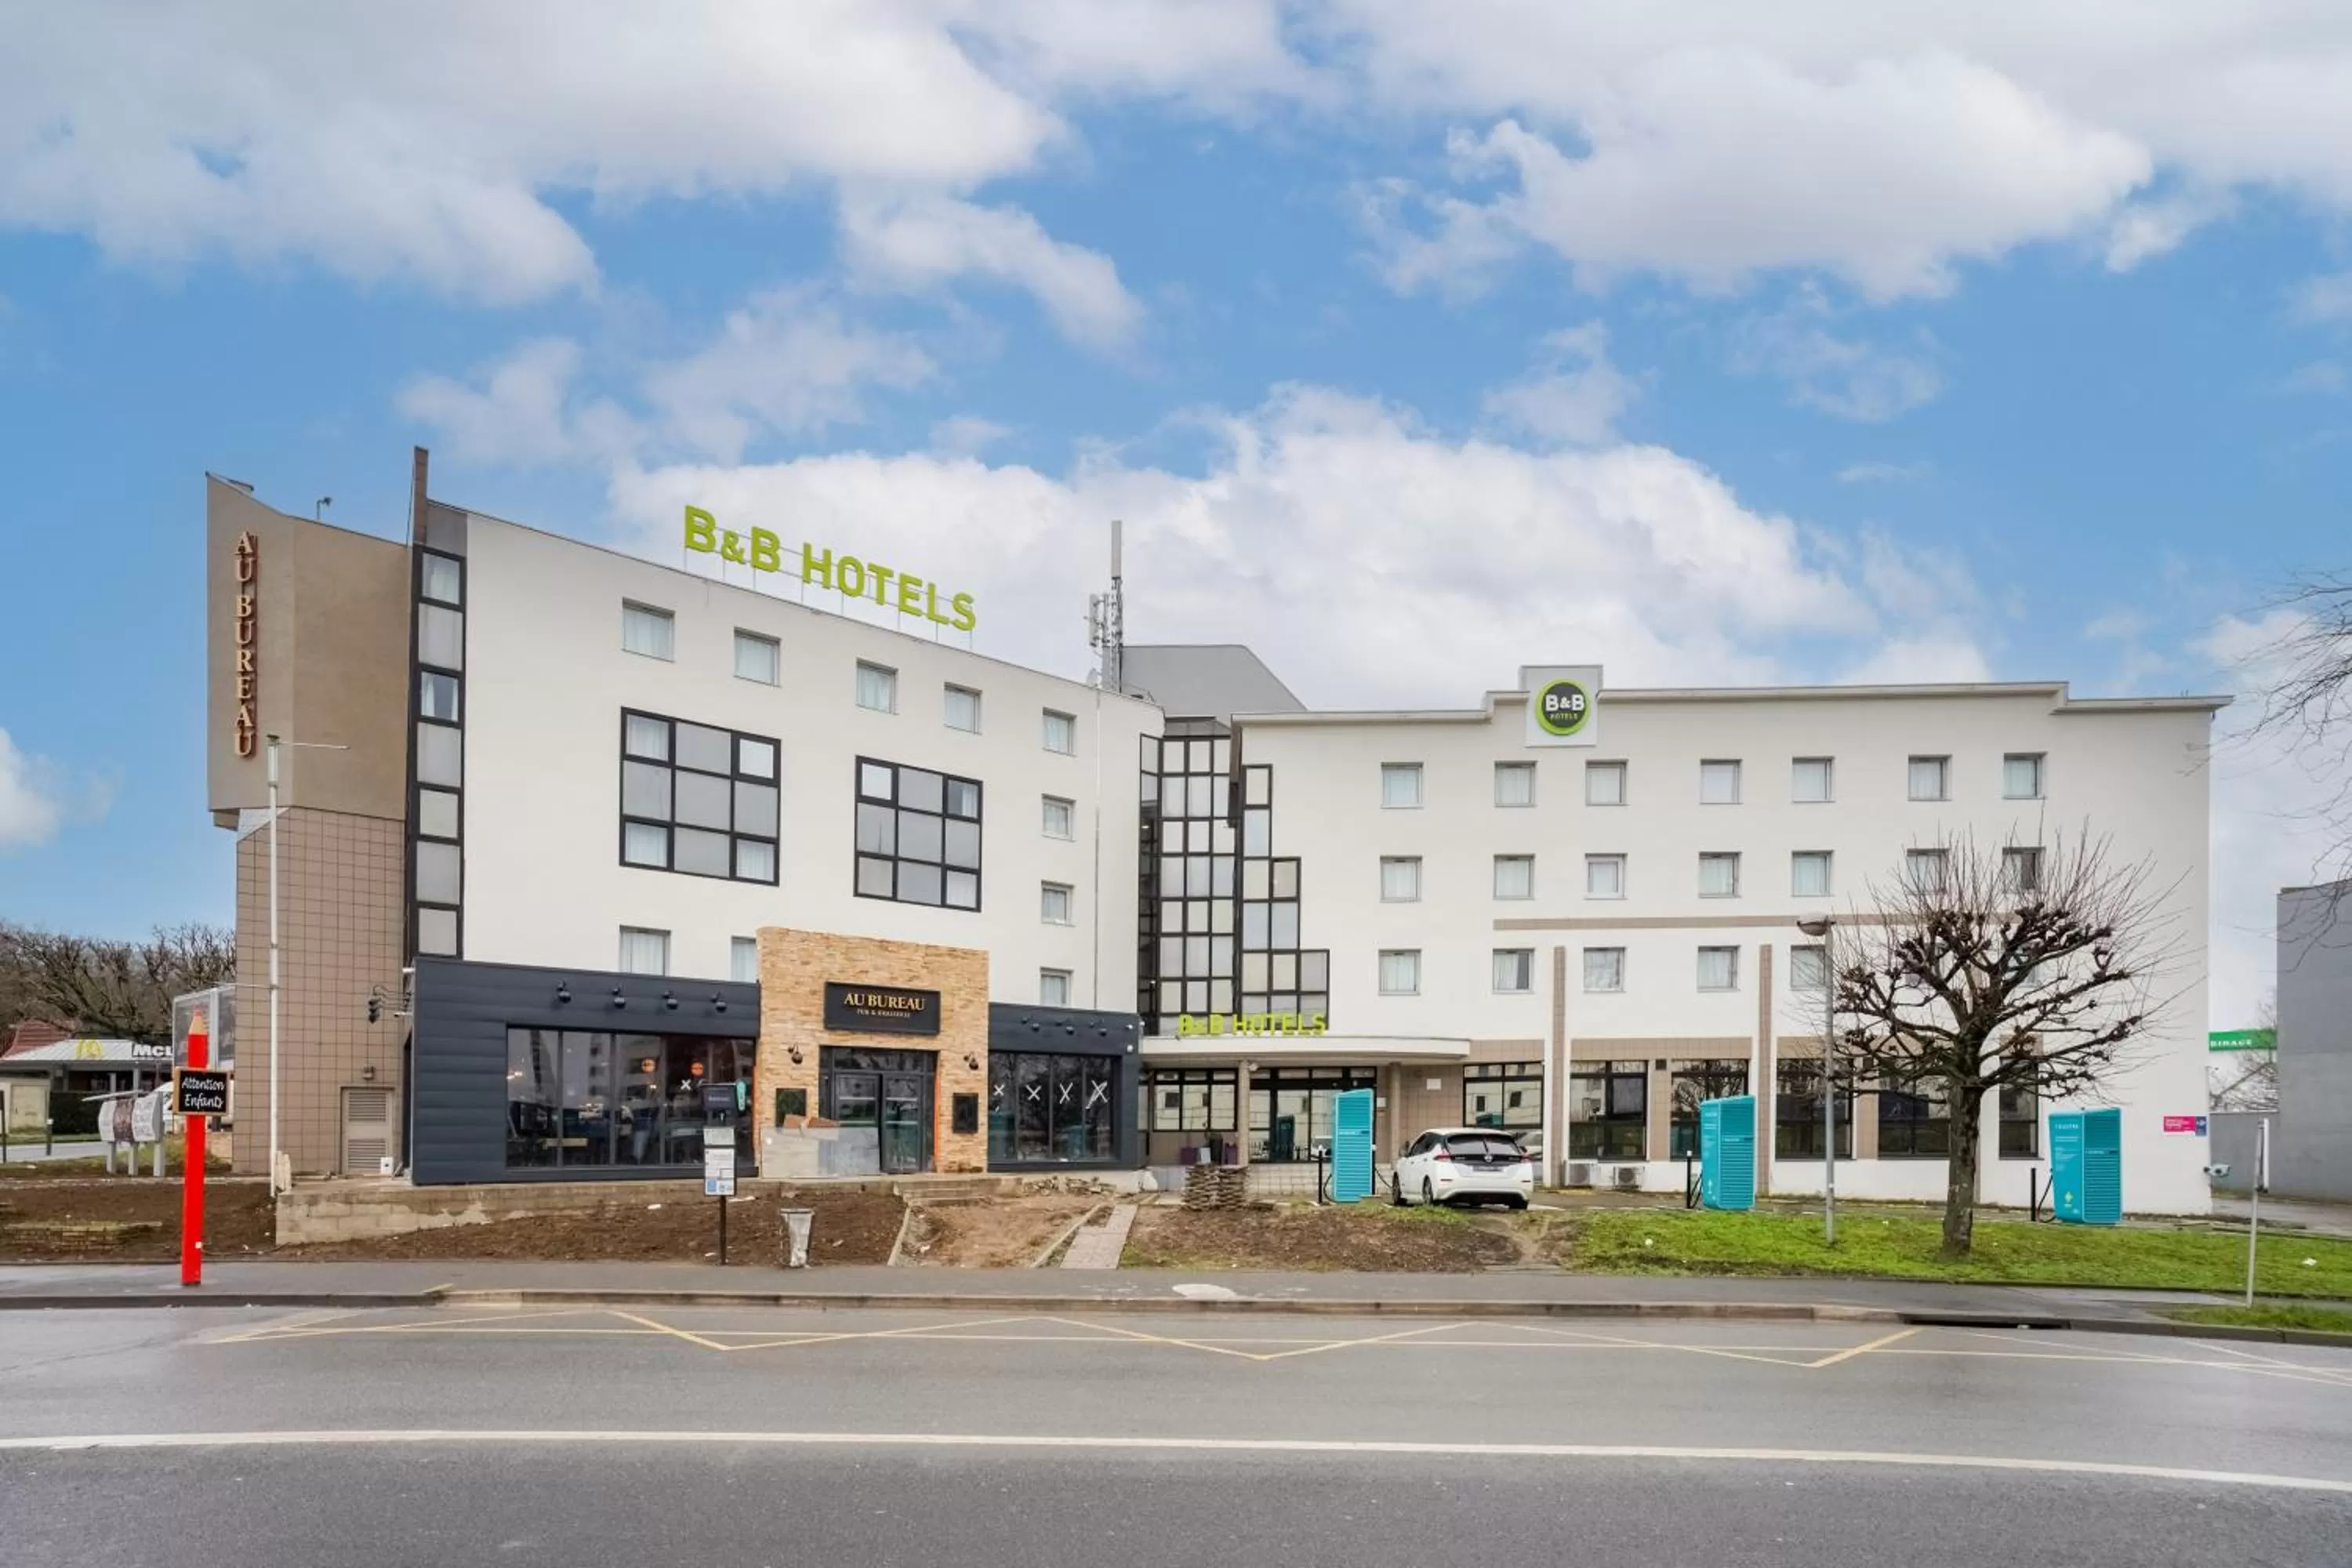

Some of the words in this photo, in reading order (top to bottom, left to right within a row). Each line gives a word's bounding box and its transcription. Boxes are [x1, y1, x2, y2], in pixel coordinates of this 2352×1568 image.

[235, 531, 255, 583] AU
[684, 504, 781, 573] B&B
[802, 542, 976, 632] HOTELS
[235, 594, 255, 757] BUREAU
[1546, 695, 1584, 711] B&B
[844, 993, 865, 1006] AU
[868, 993, 925, 1011] BUREAU
[1178, 1014, 1225, 1036] B&B
[1232, 1013, 1327, 1036] HOTELS
[182, 1076, 225, 1091] Attention
